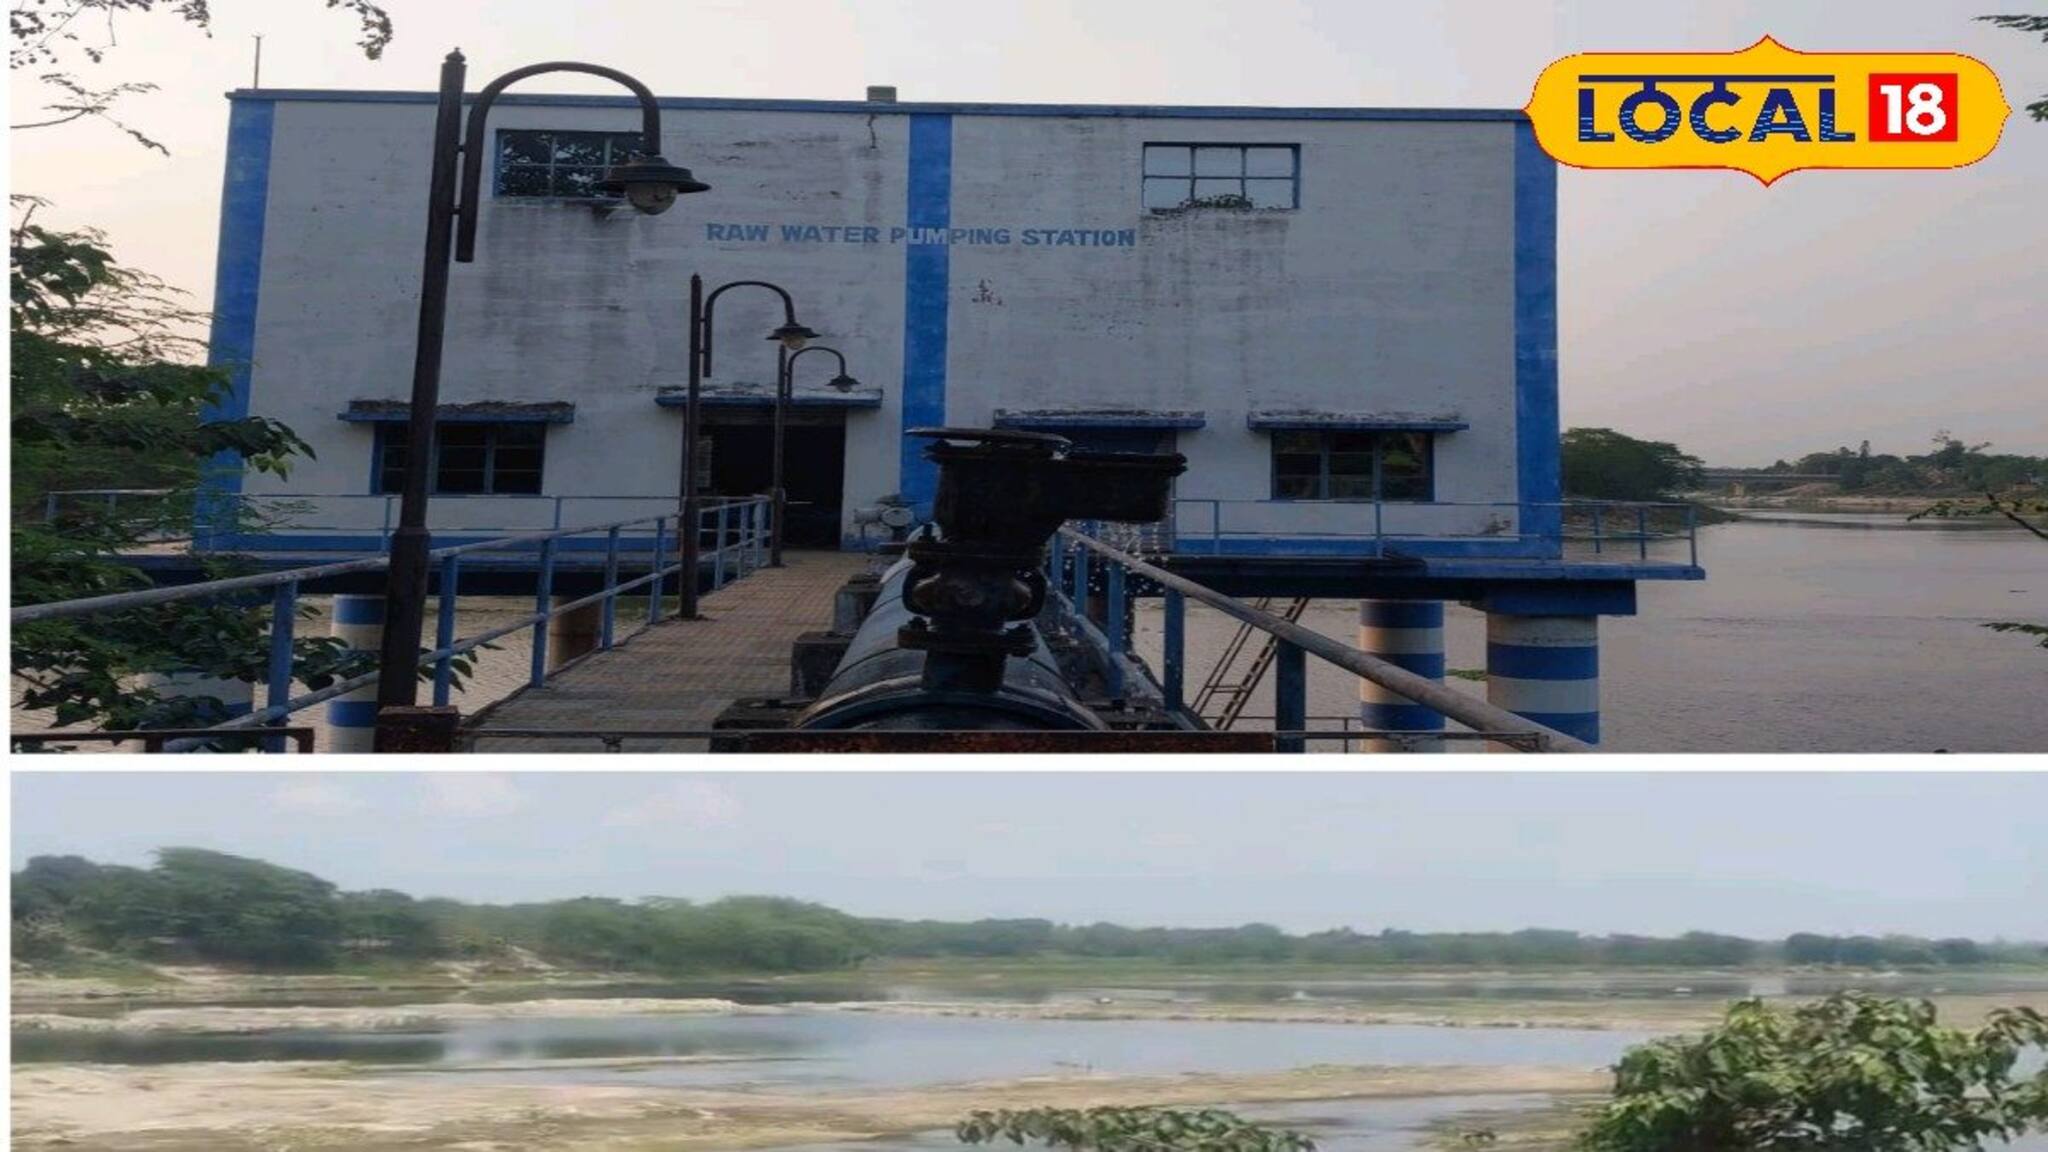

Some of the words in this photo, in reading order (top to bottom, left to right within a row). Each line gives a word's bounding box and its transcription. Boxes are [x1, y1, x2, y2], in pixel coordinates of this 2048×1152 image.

[707, 223, 770, 242] RAW
[780, 225, 880, 244] WATER
[890, 226, 1010, 246] PUMPING
[1021, 228, 1135, 247] STATION
